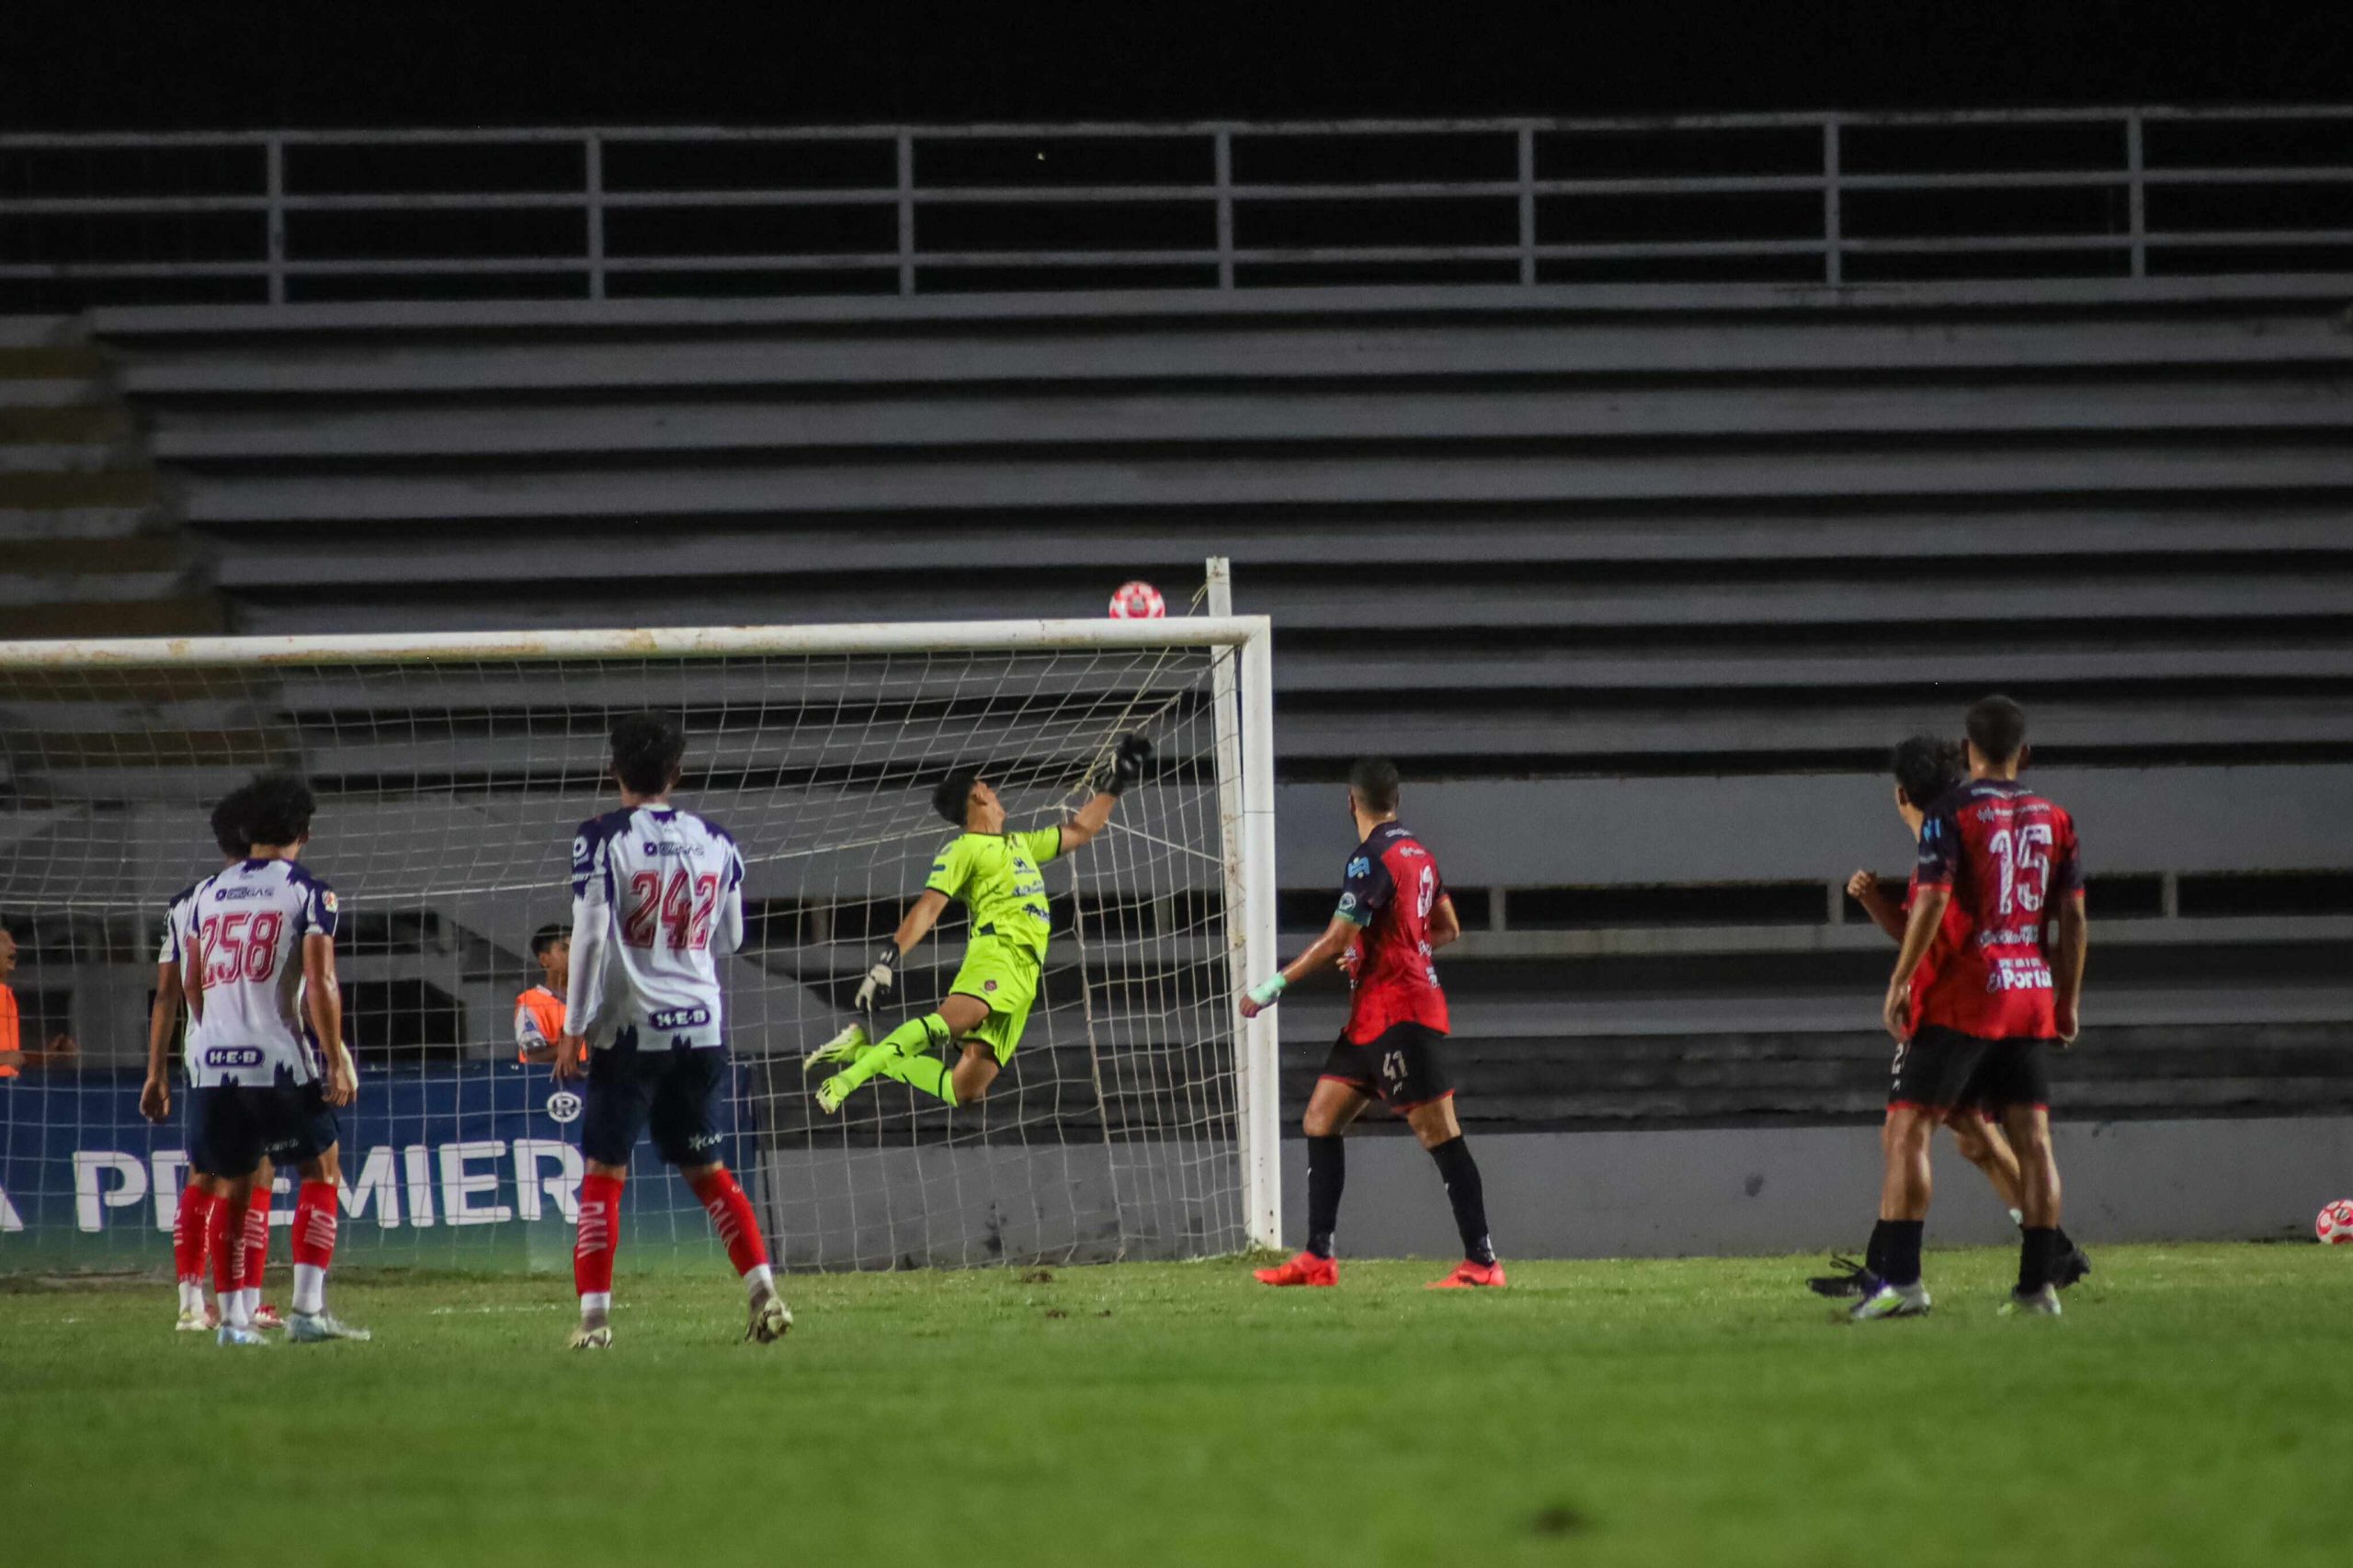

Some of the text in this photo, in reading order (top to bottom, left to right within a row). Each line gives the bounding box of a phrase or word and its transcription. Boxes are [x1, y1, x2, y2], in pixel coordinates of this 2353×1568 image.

[622, 869, 719, 950] 242
[1989, 824, 2052, 915] 15
[201, 911, 283, 990] 258
[1382, 1051, 1408, 1080] 41
